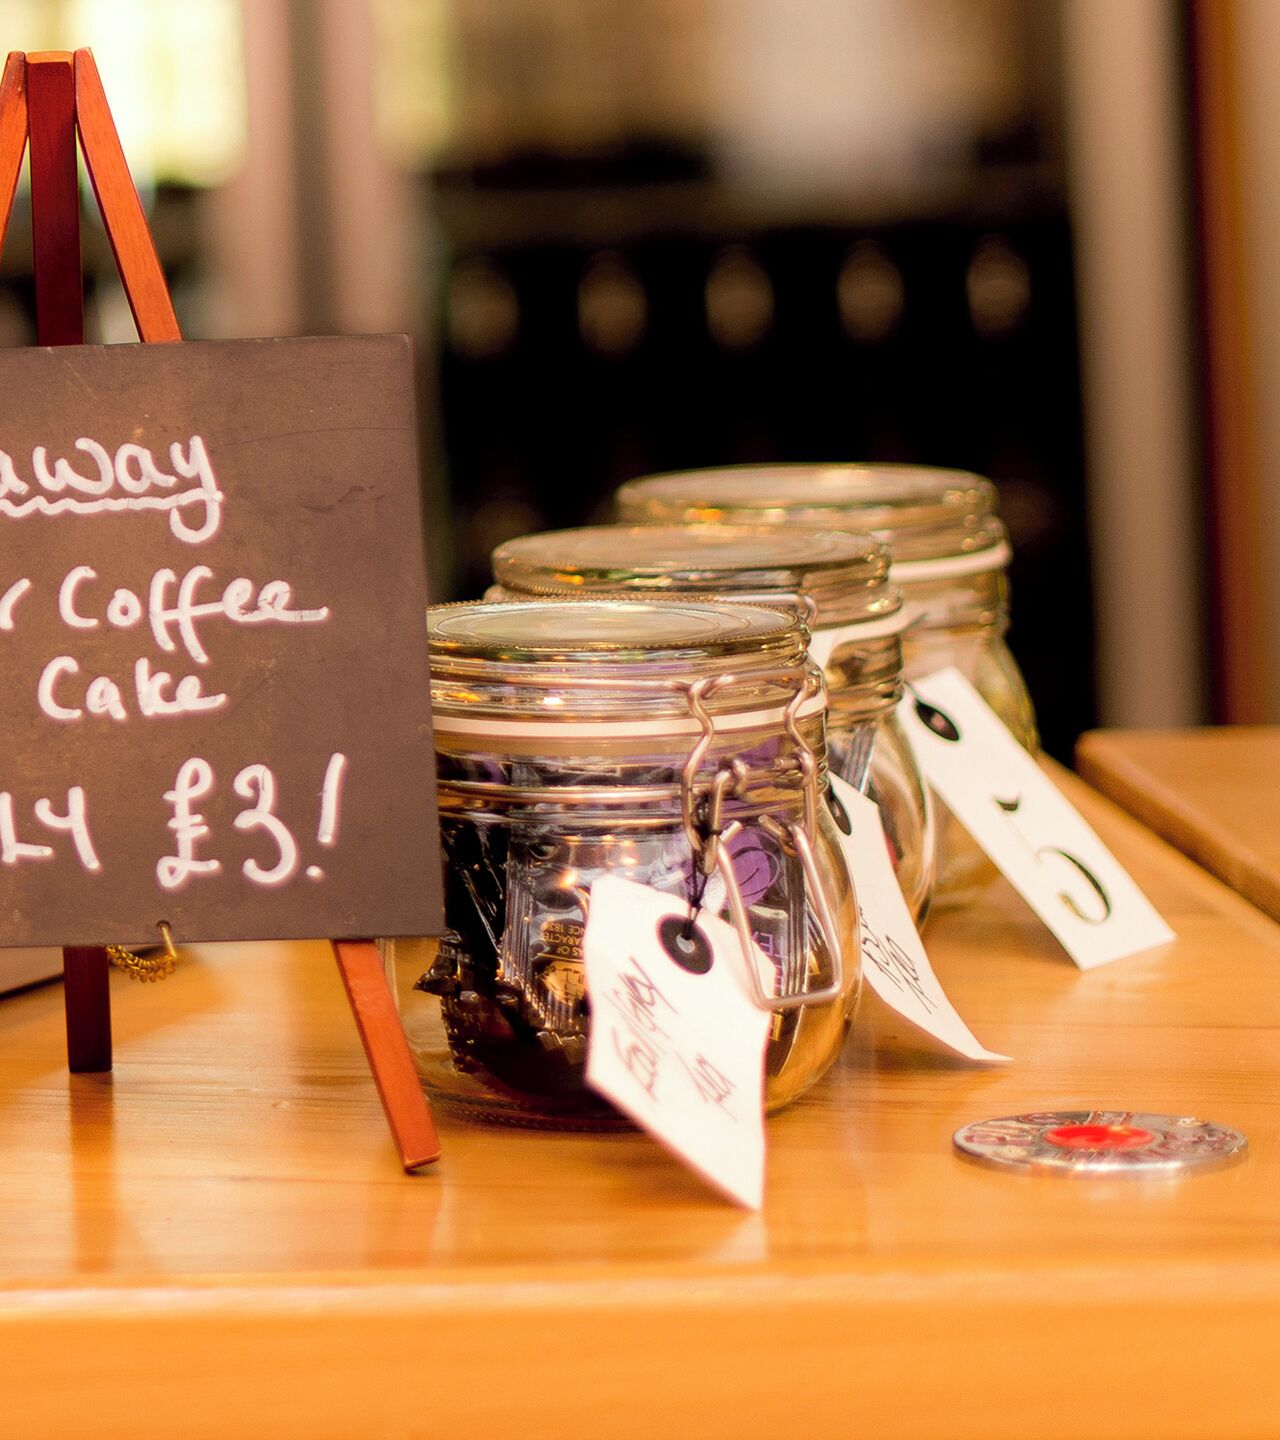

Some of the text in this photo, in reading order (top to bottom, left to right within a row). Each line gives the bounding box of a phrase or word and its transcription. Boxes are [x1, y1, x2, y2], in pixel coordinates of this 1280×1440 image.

[58, 564, 330, 663] Coffee
[36, 654, 227, 720] Cake
[156, 751, 346, 891] £3!
